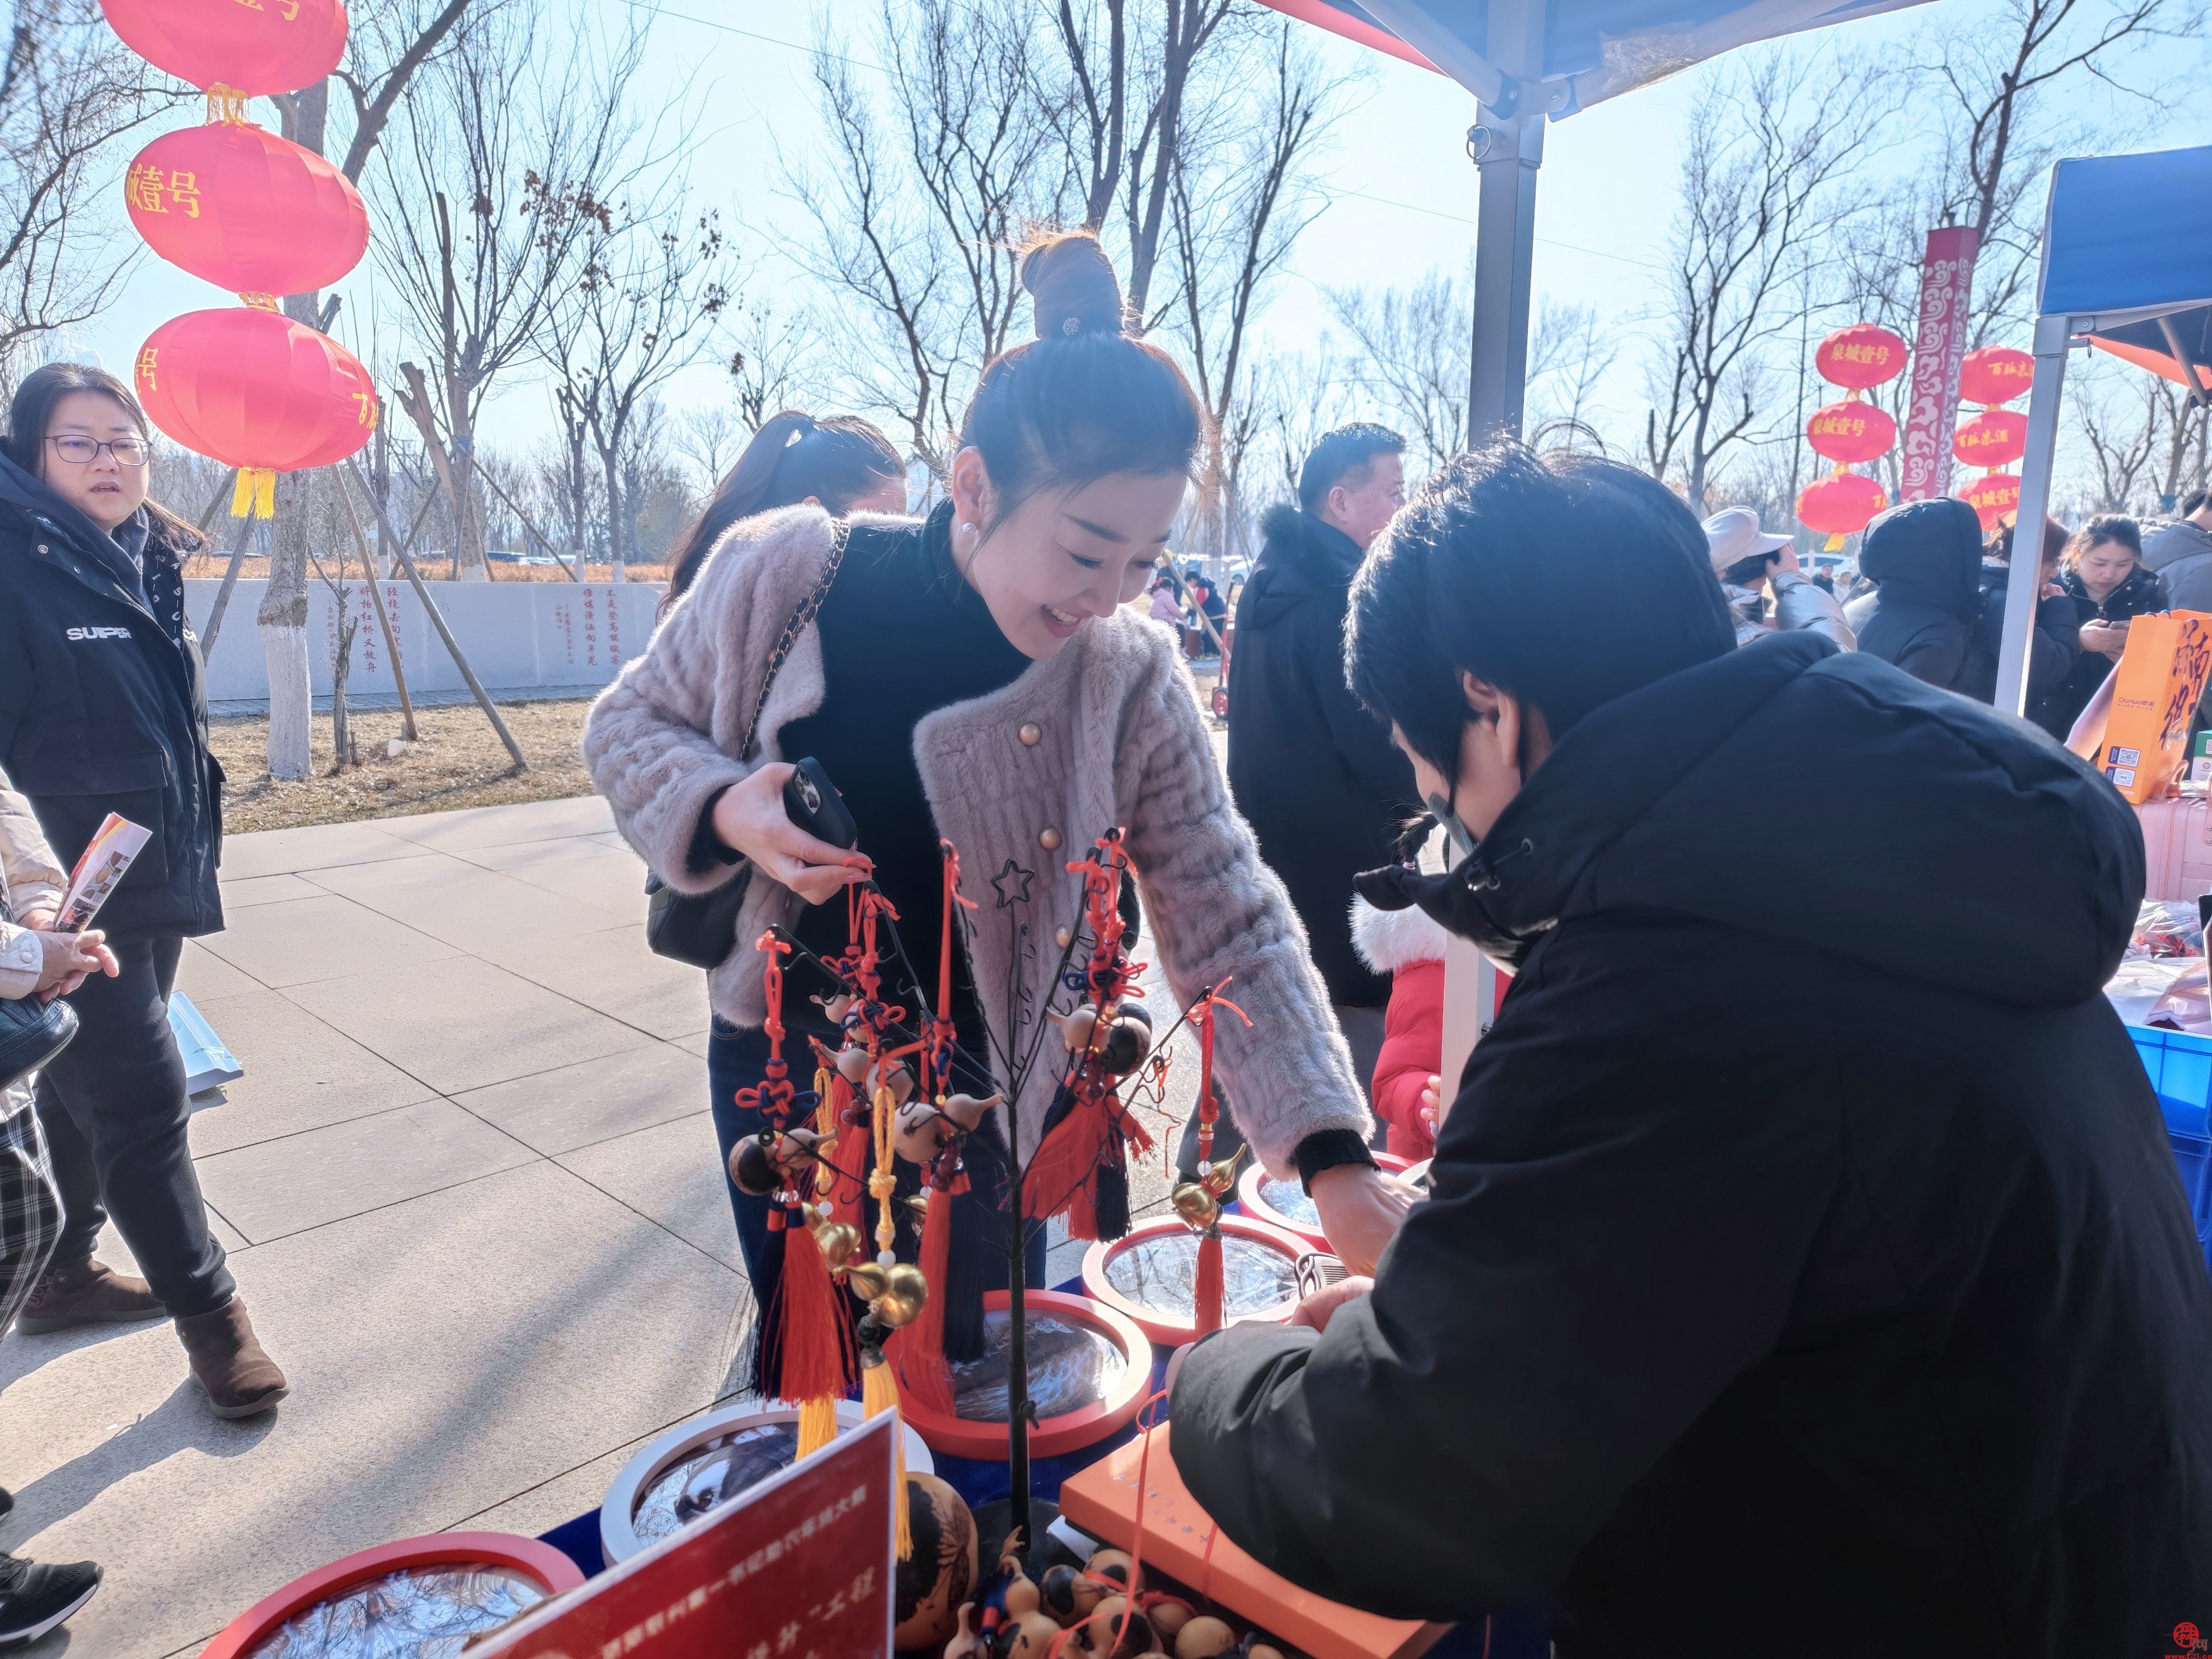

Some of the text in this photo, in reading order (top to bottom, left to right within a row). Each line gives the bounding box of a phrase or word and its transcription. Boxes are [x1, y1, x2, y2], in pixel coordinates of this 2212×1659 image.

[1830, 343, 1891, 366] 泉城壹号
[137, 347, 159, 394] 号
[1811, 417, 1867, 438] 泉城壹号
[66, 626, 133, 641] SUPER
